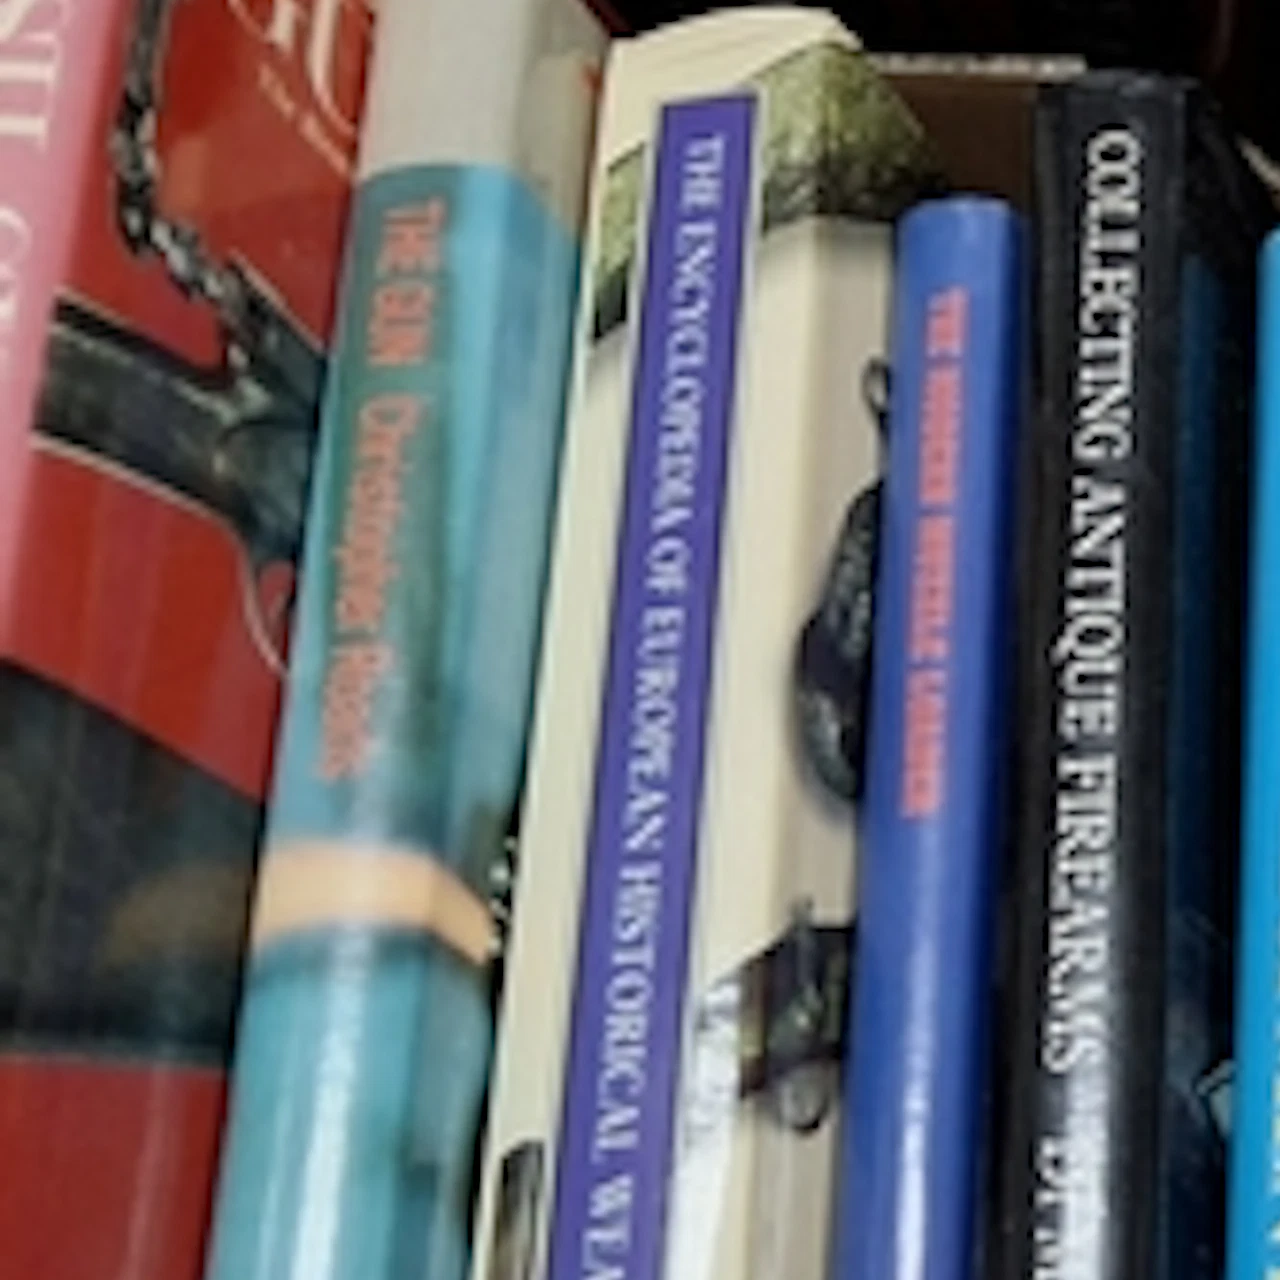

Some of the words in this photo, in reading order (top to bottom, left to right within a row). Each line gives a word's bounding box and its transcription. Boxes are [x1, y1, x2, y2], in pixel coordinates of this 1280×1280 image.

[678, 135, 727, 211] THE
[1071, 127, 1142, 461] COLLECTING
[650, 222, 718, 533] ENCYCLOPEDIA
[642, 538, 690, 601] OF
[1053, 474, 1128, 742] ANTIQUE
[621, 608, 685, 850] EUROPEAN
[592, 869, 664, 1166] HISTORICAL
[1040, 751, 1119, 1072] FIREARMS
